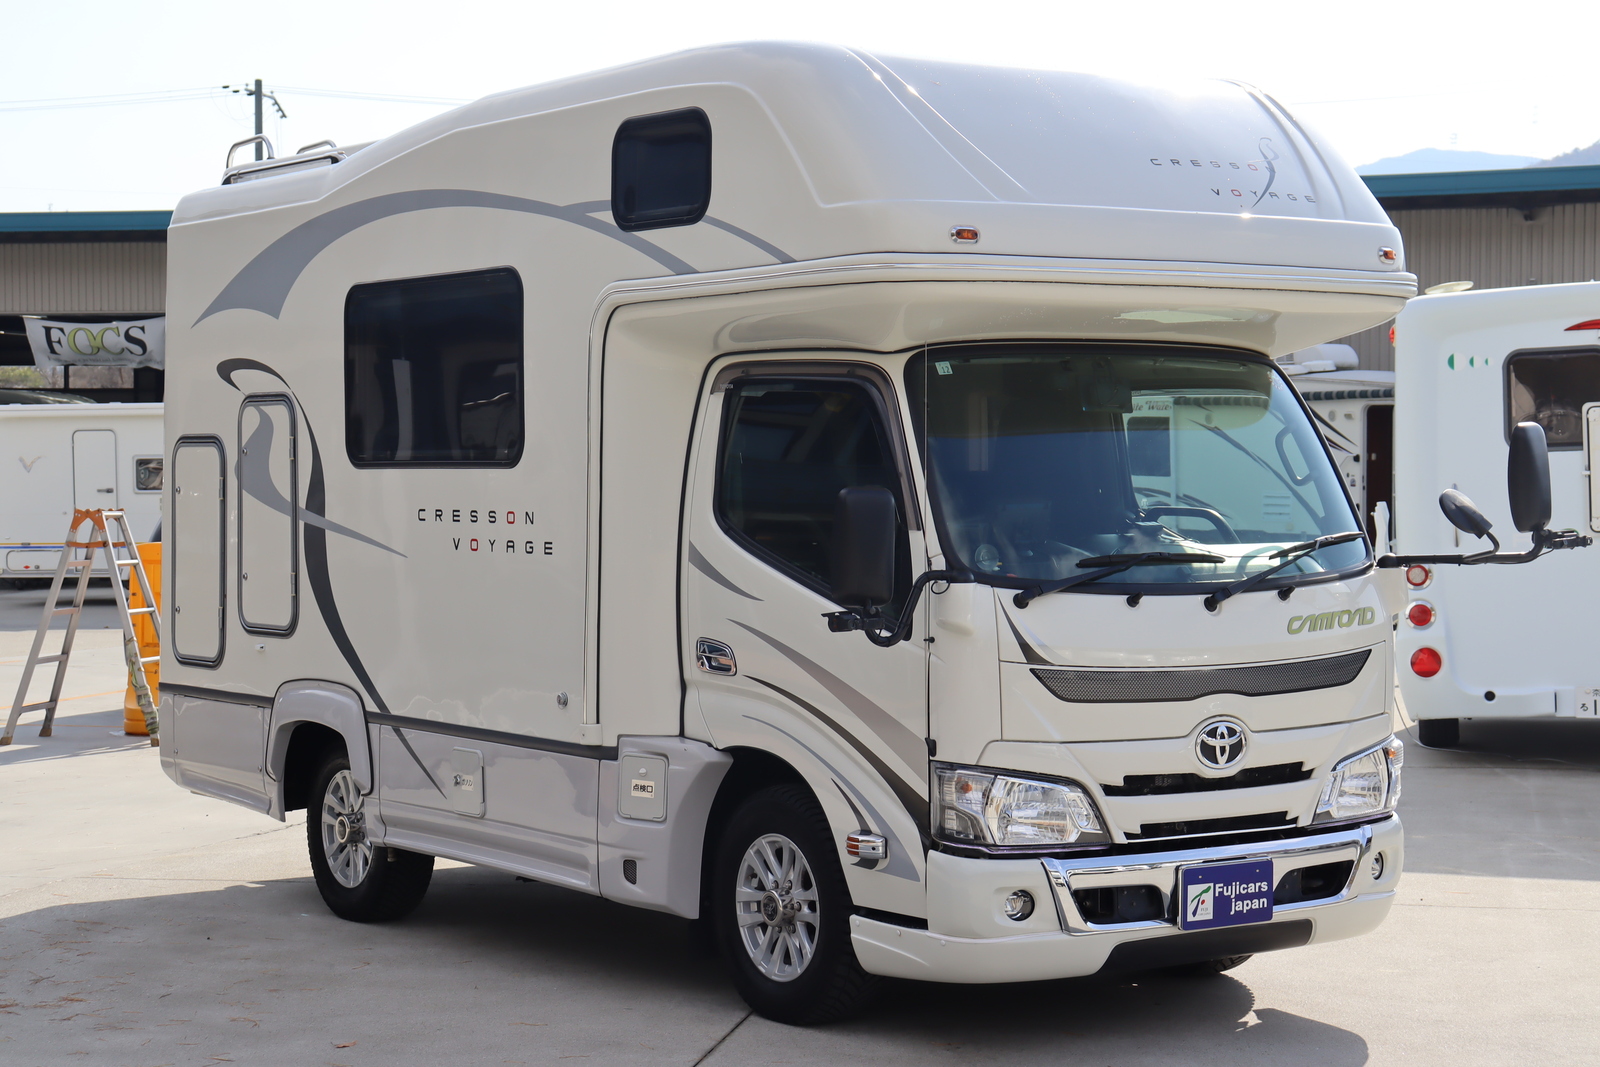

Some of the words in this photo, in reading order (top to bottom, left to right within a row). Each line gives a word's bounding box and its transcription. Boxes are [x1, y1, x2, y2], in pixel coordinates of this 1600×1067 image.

[1211, 188, 1316, 203] VOYAGE
[42, 325, 148, 356] FOCS
[418, 508, 534, 525] CRESSON
[453, 537, 553, 555] VOYAGE
[632, 783, 654, 794] 点検口
[1215, 881, 1268, 898] Fujicars
[1230, 897, 1268, 915] japan
